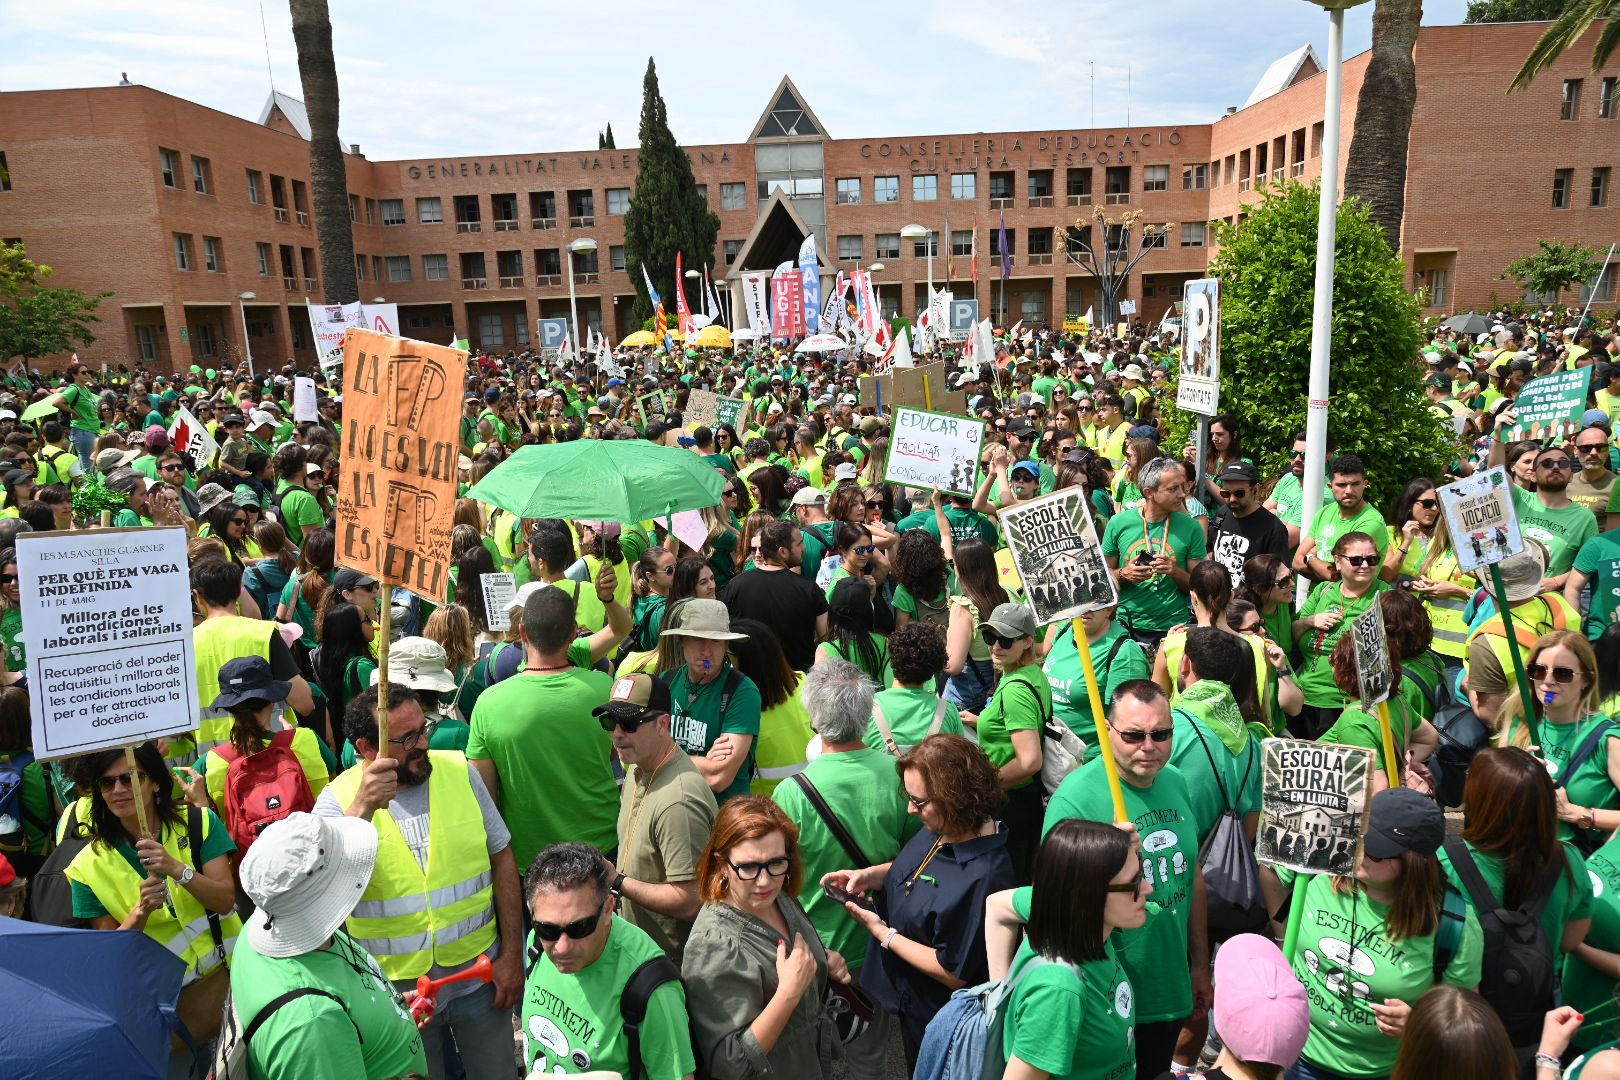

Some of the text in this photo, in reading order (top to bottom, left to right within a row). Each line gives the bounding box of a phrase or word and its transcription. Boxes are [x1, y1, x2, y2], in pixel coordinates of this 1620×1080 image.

[860, 138, 1023, 158] CONSELLERIA
[408, 151, 731, 179] GENERALITAT VALEANA
[908, 155, 1009, 173] CULTURA
[1050, 150, 1140, 167] ESPORT
[752, 284, 761, 319] STEP
[776, 280, 789, 326] UGT
[804, 267, 818, 335] ANP
[956, 303, 973, 327] P
[544, 322, 560, 345] P
[1187, 292, 1210, 367] P
[353, 350, 447, 432] LA FP
[1519, 380, 1583, 398] COMPANYS DE
[1523, 371, 1584, 391] LLUITEM PELS
[1180, 387, 1212, 406] AUTORITATS
[1512, 398, 1581, 415] QUE NO PODEN
[1532, 393, 1565, 404] 2n Bat.
[901, 412, 958, 437] EDUCAR
[1524, 411, 1554, 422] ESTAR
[349, 418, 377, 463] NO
[381, 429, 411, 473] ES
[353, 471, 377, 509] LA
[383, 480, 438, 545] FP
[1018, 505, 1069, 536] ESCOLA
[1024, 520, 1078, 551] RURAL
[118, 543, 165, 556] GUARNER
[1038, 538, 1076, 558] EN LLUITA
[91, 557, 120, 566] SILLA
[38, 563, 180, 586] PER QUÈ FEM VAGA
[39, 579, 132, 598] INDEFINIDA
[55, 598, 68, 607] DE
[71, 595, 96, 605] MAIG
[61, 603, 164, 625] Millora de les
[67, 615, 160, 635] condiciones
[1360, 611, 1377, 636] ESC
[43, 622, 182, 650] laborals i salarials
[44, 652, 182, 680] Recuperació del poder
[48, 675, 112, 694] adquisitiu
[121, 669, 163, 683] millora
[165, 665, 180, 676] de
[50, 678, 181, 707] les condicions laborals
[53, 690, 180, 722] per a fer atractiva la
[91, 712, 149, 728] docència.
[1280, 750, 1343, 774] ESCOLA
[1281, 769, 1347, 796] RURAL
[1290, 791, 1339, 809] EN LLUITA
[1134, 808, 1180, 832] STIMEM
[1316, 909, 1406, 966] ESTIMEM
